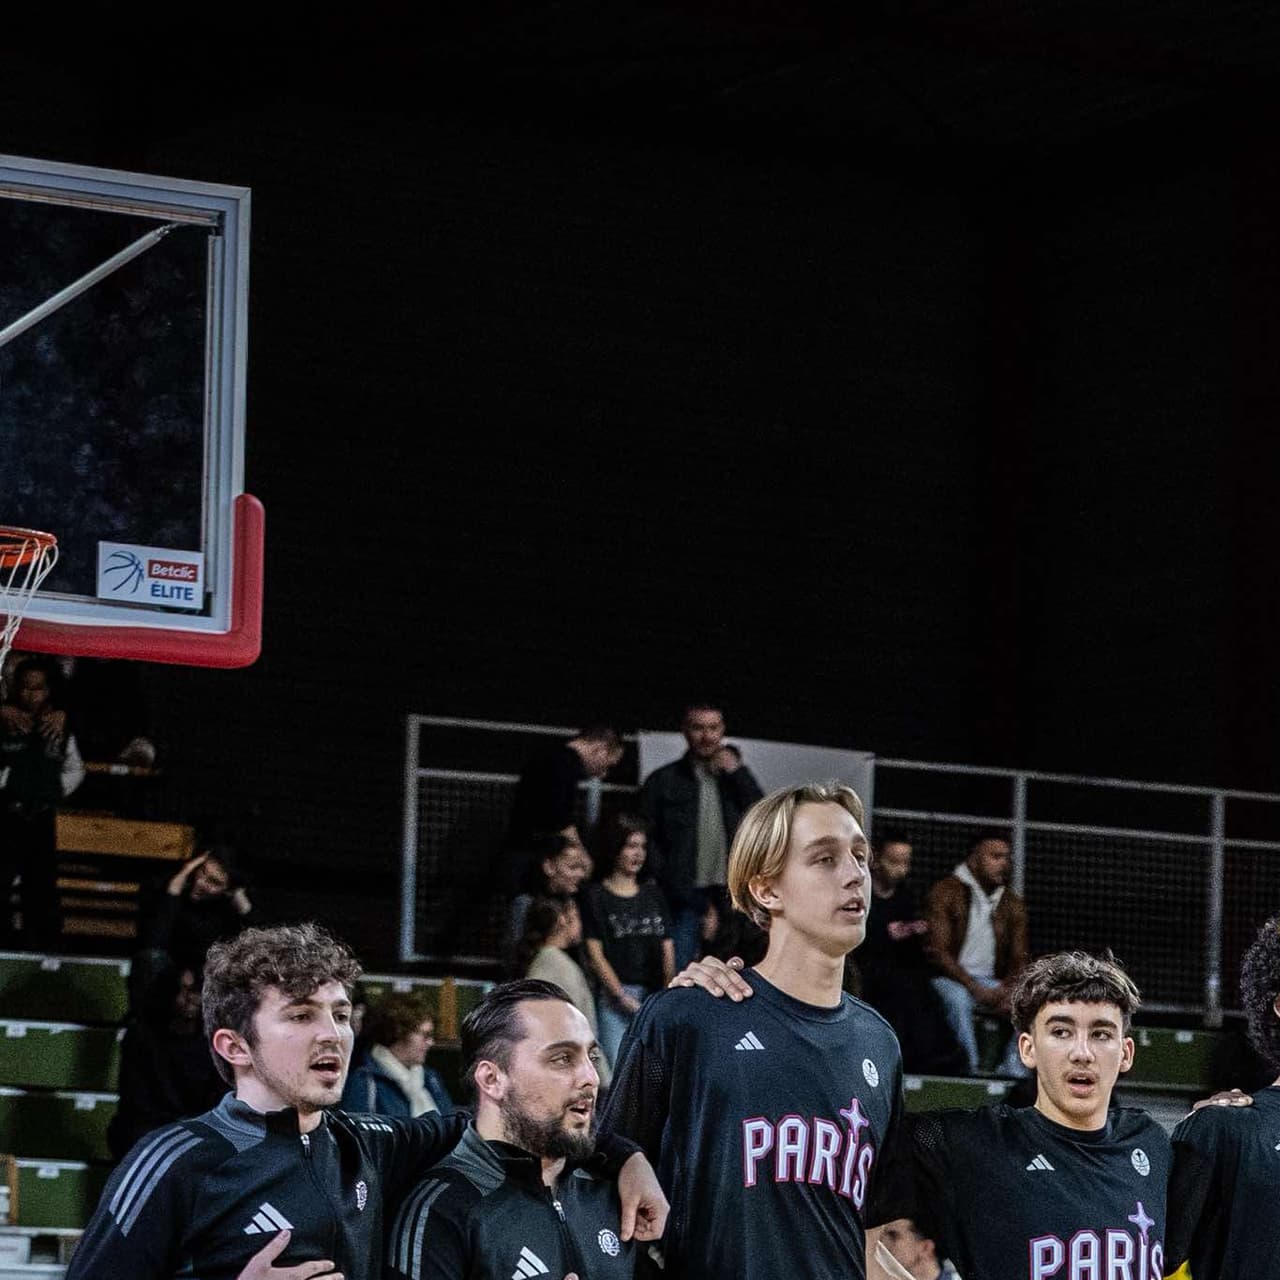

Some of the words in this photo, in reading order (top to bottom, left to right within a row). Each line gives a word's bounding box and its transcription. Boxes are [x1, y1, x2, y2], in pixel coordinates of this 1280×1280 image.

[151, 563, 196, 579] Betclic
[151, 580, 194, 601] ÉLITE
[743, 1098, 874, 1211] PARIS
